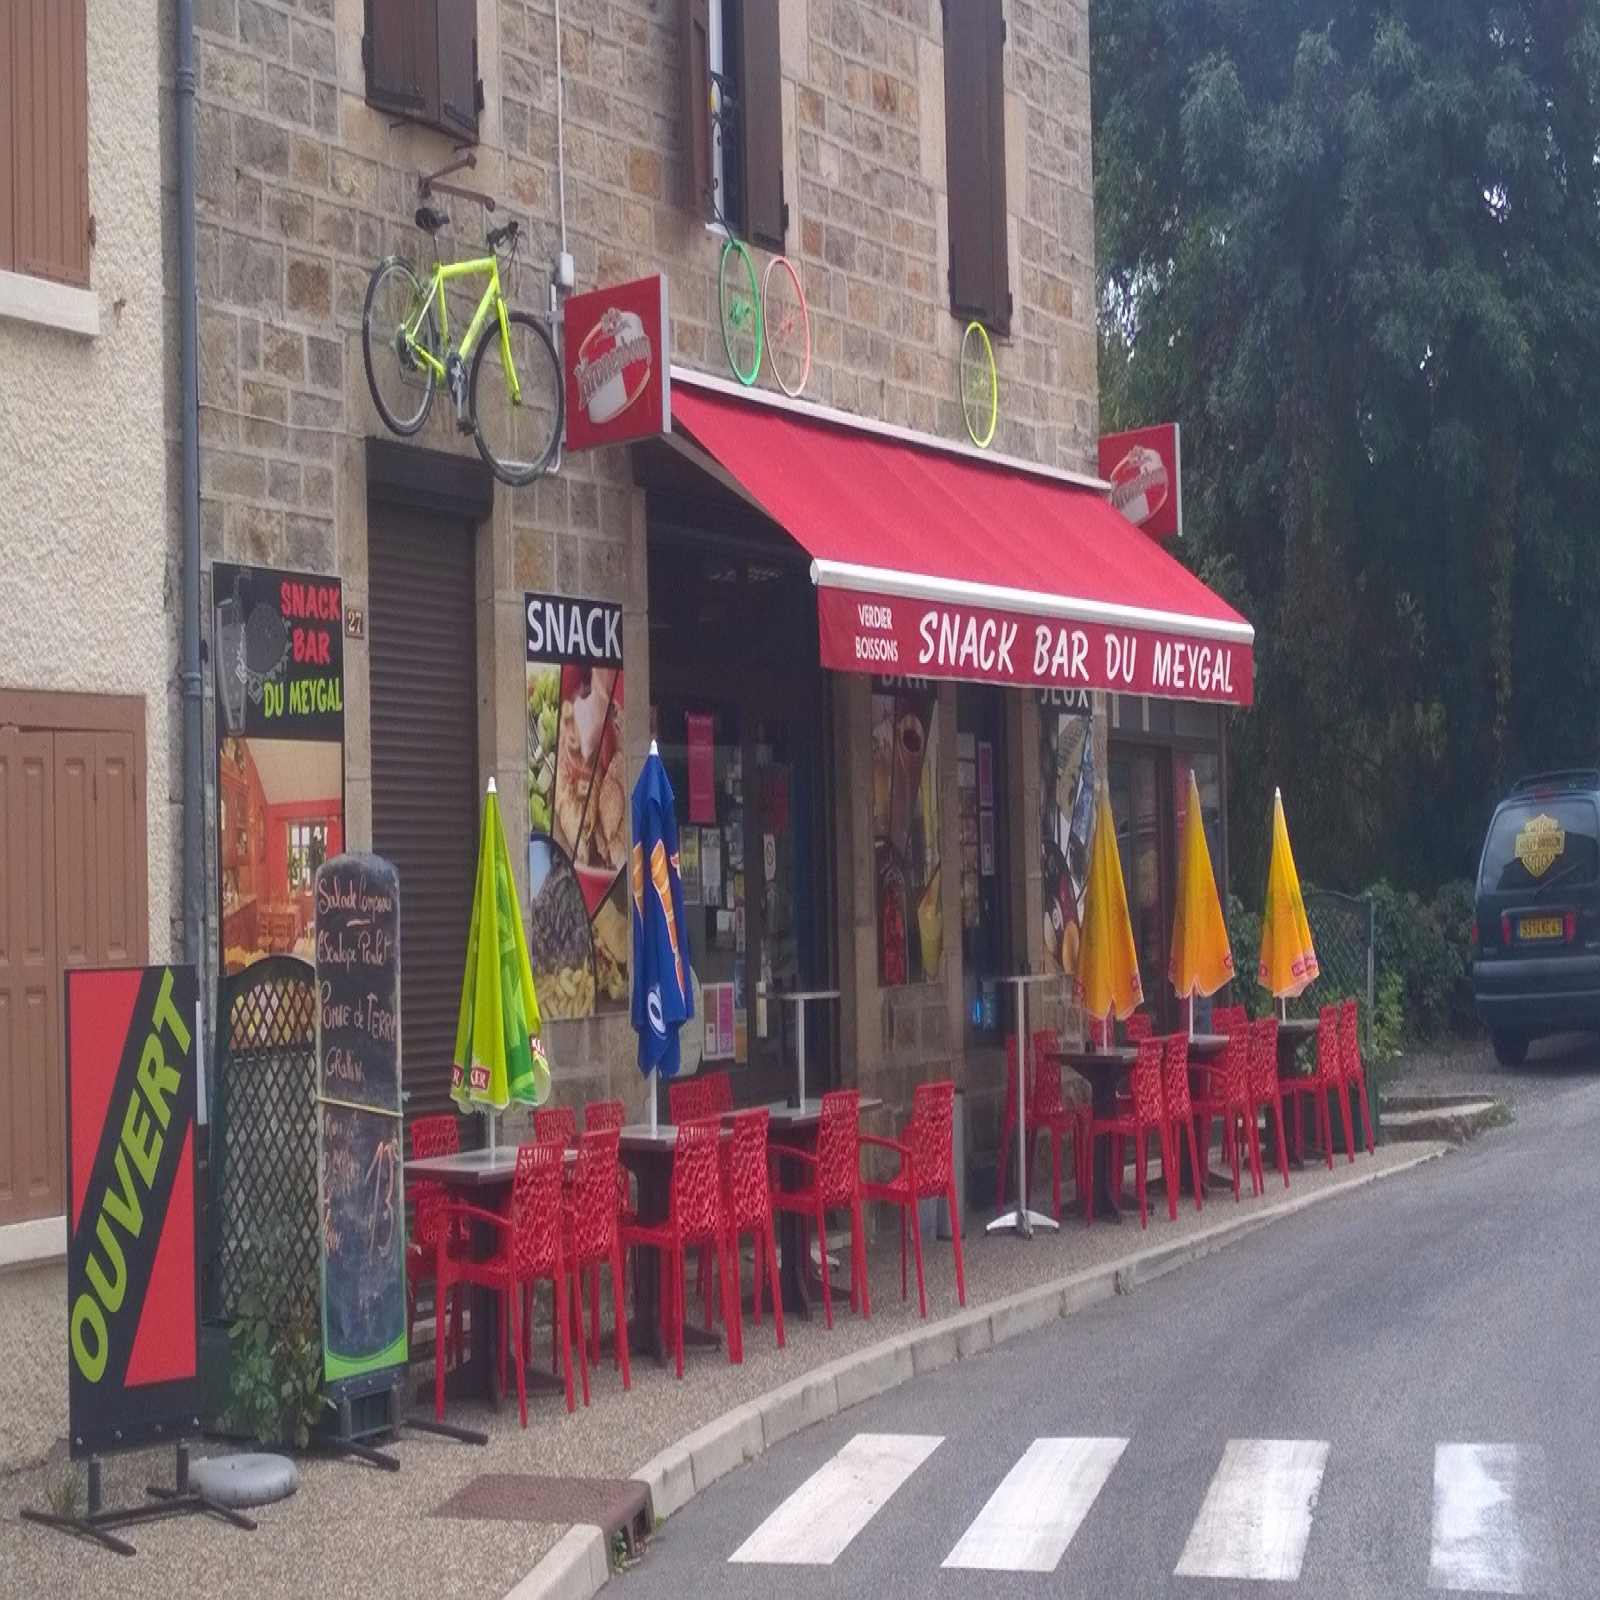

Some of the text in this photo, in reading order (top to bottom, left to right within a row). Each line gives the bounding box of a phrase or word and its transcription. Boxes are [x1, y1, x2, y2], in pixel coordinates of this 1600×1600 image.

[281, 582, 341, 620] SNACK
[857, 604, 893, 630] VERDIER
[348, 611, 361, 633] 27
[528, 601, 621, 658] SNACK
[293, 628, 331, 665] BAR
[855, 636, 898, 662] BOISSONS
[919, 611, 1233, 693] SNACK BAR DU MEYGAL
[263, 677, 343, 718] DU MEYGAL
[70, 965, 192, 1383] OUVERT
